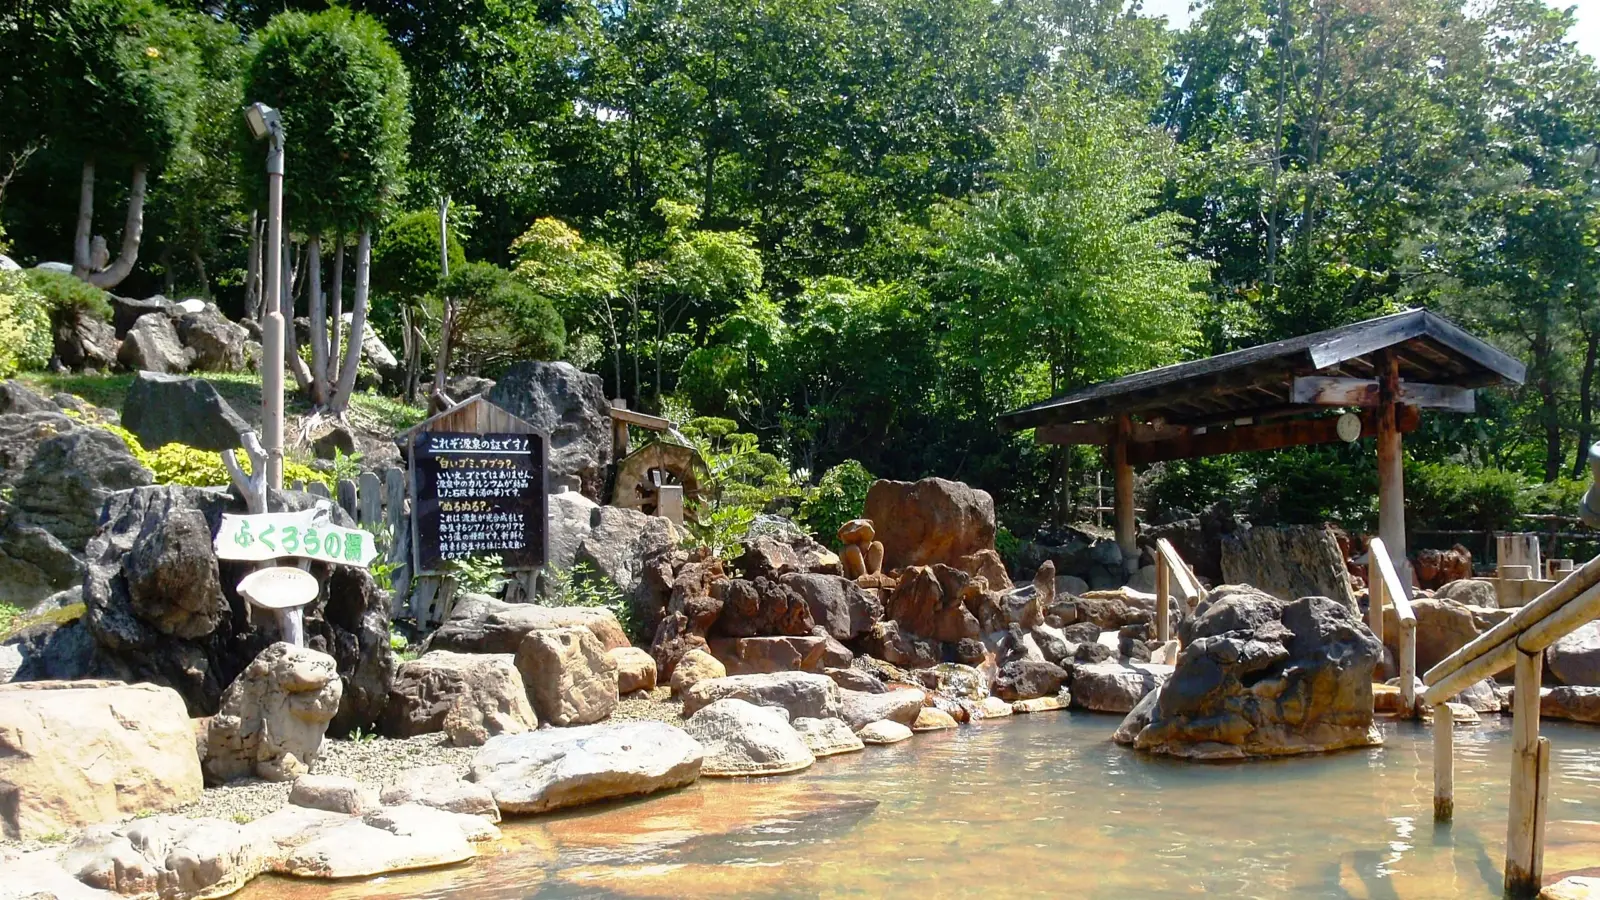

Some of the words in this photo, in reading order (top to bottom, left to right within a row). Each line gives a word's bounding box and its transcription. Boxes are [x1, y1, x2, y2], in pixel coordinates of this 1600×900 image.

[234, 519, 363, 562] ふくろうの湯
